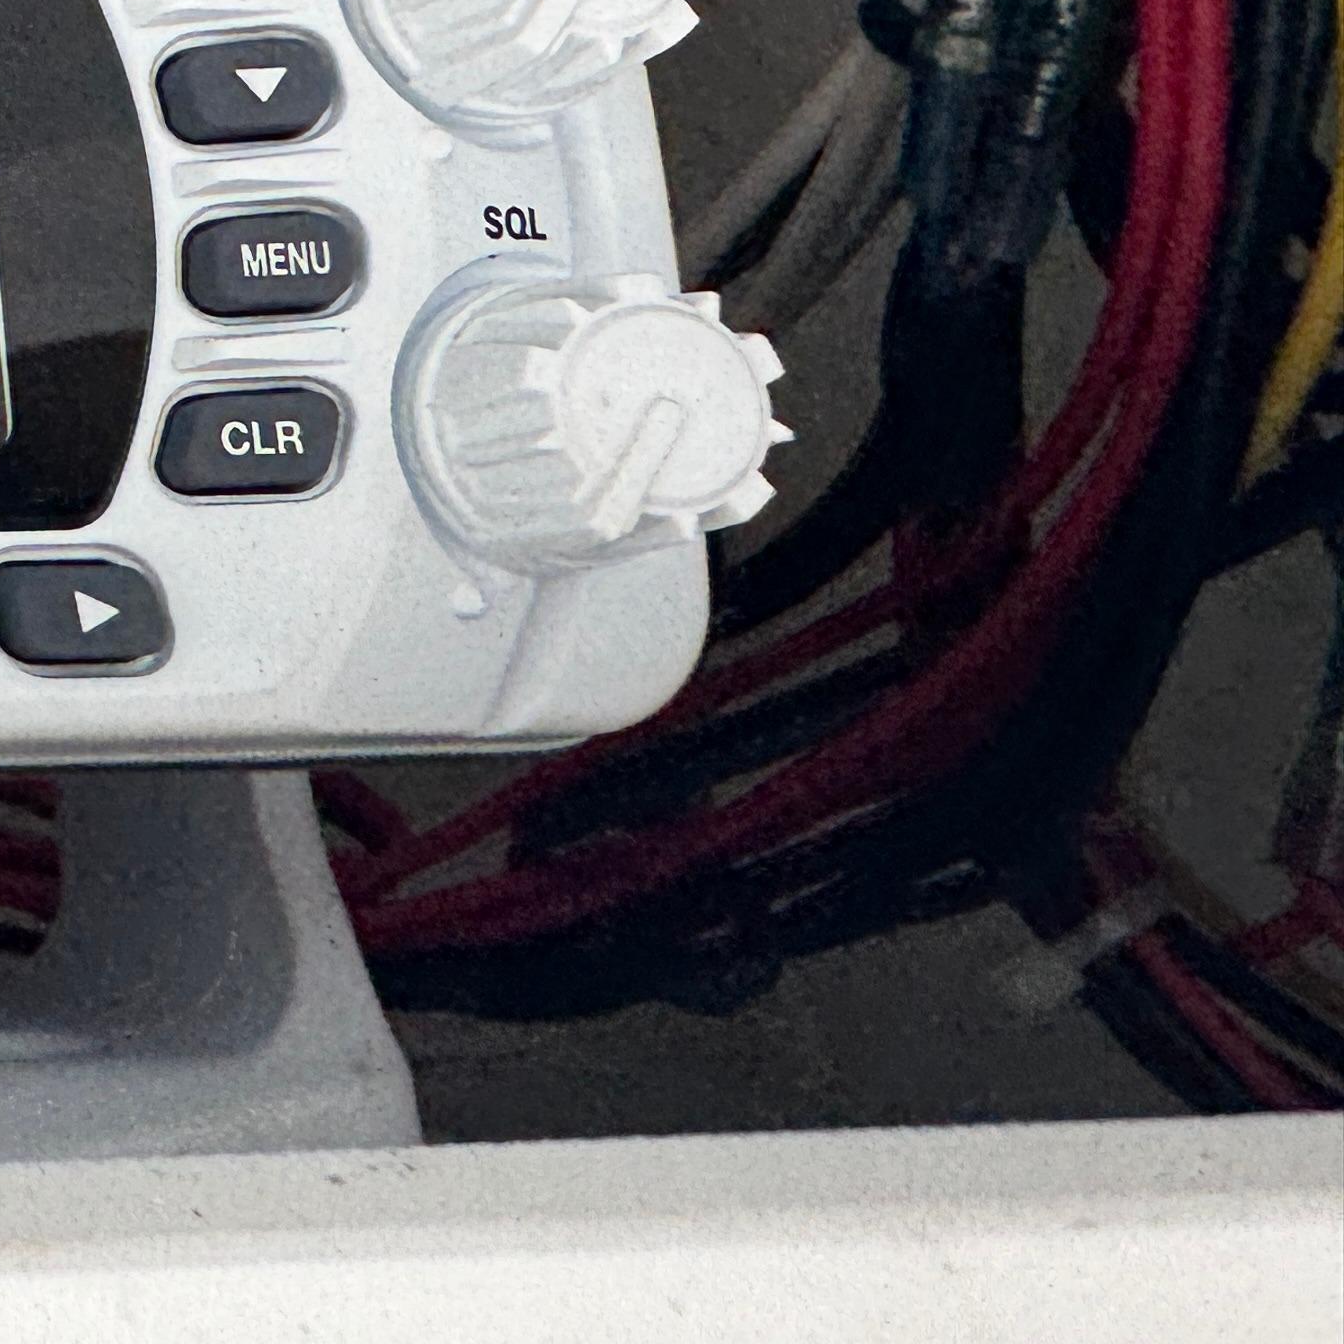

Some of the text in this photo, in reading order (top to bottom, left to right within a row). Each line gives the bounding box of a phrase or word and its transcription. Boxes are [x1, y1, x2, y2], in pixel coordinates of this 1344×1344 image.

[483, 205, 548, 242] SQL
[241, 241, 332, 279] MENU
[220, 421, 304, 457] CLR
